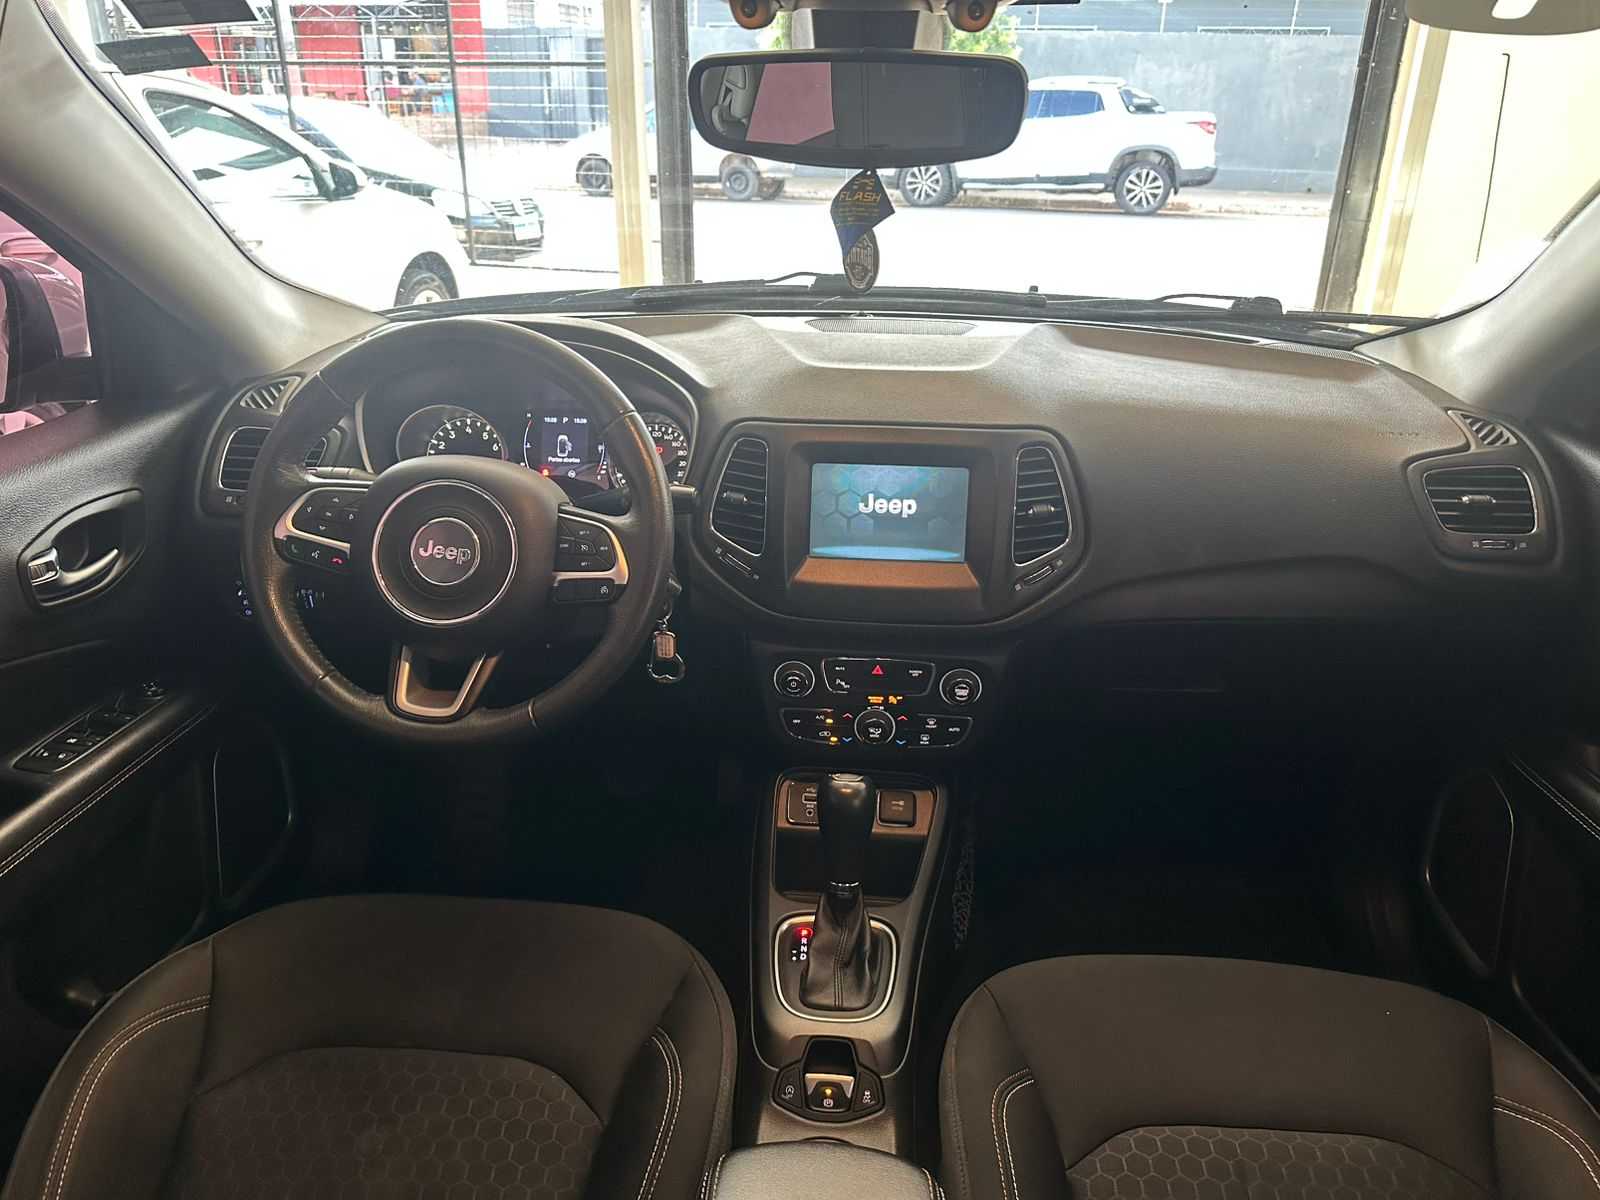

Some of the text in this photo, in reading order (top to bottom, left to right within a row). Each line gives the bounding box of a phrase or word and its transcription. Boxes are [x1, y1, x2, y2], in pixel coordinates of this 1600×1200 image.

[839, 190, 882, 203] FLASH
[562, 416, 569, 424] P
[465, 426, 472, 434] 4
[448, 430, 456, 439] 3
[482, 432, 489, 440] 5
[438, 441, 446, 449] 2
[492, 443, 499, 451] 6
[858, 493, 918, 518] Jeep
[418, 539, 472, 565] Jeep
